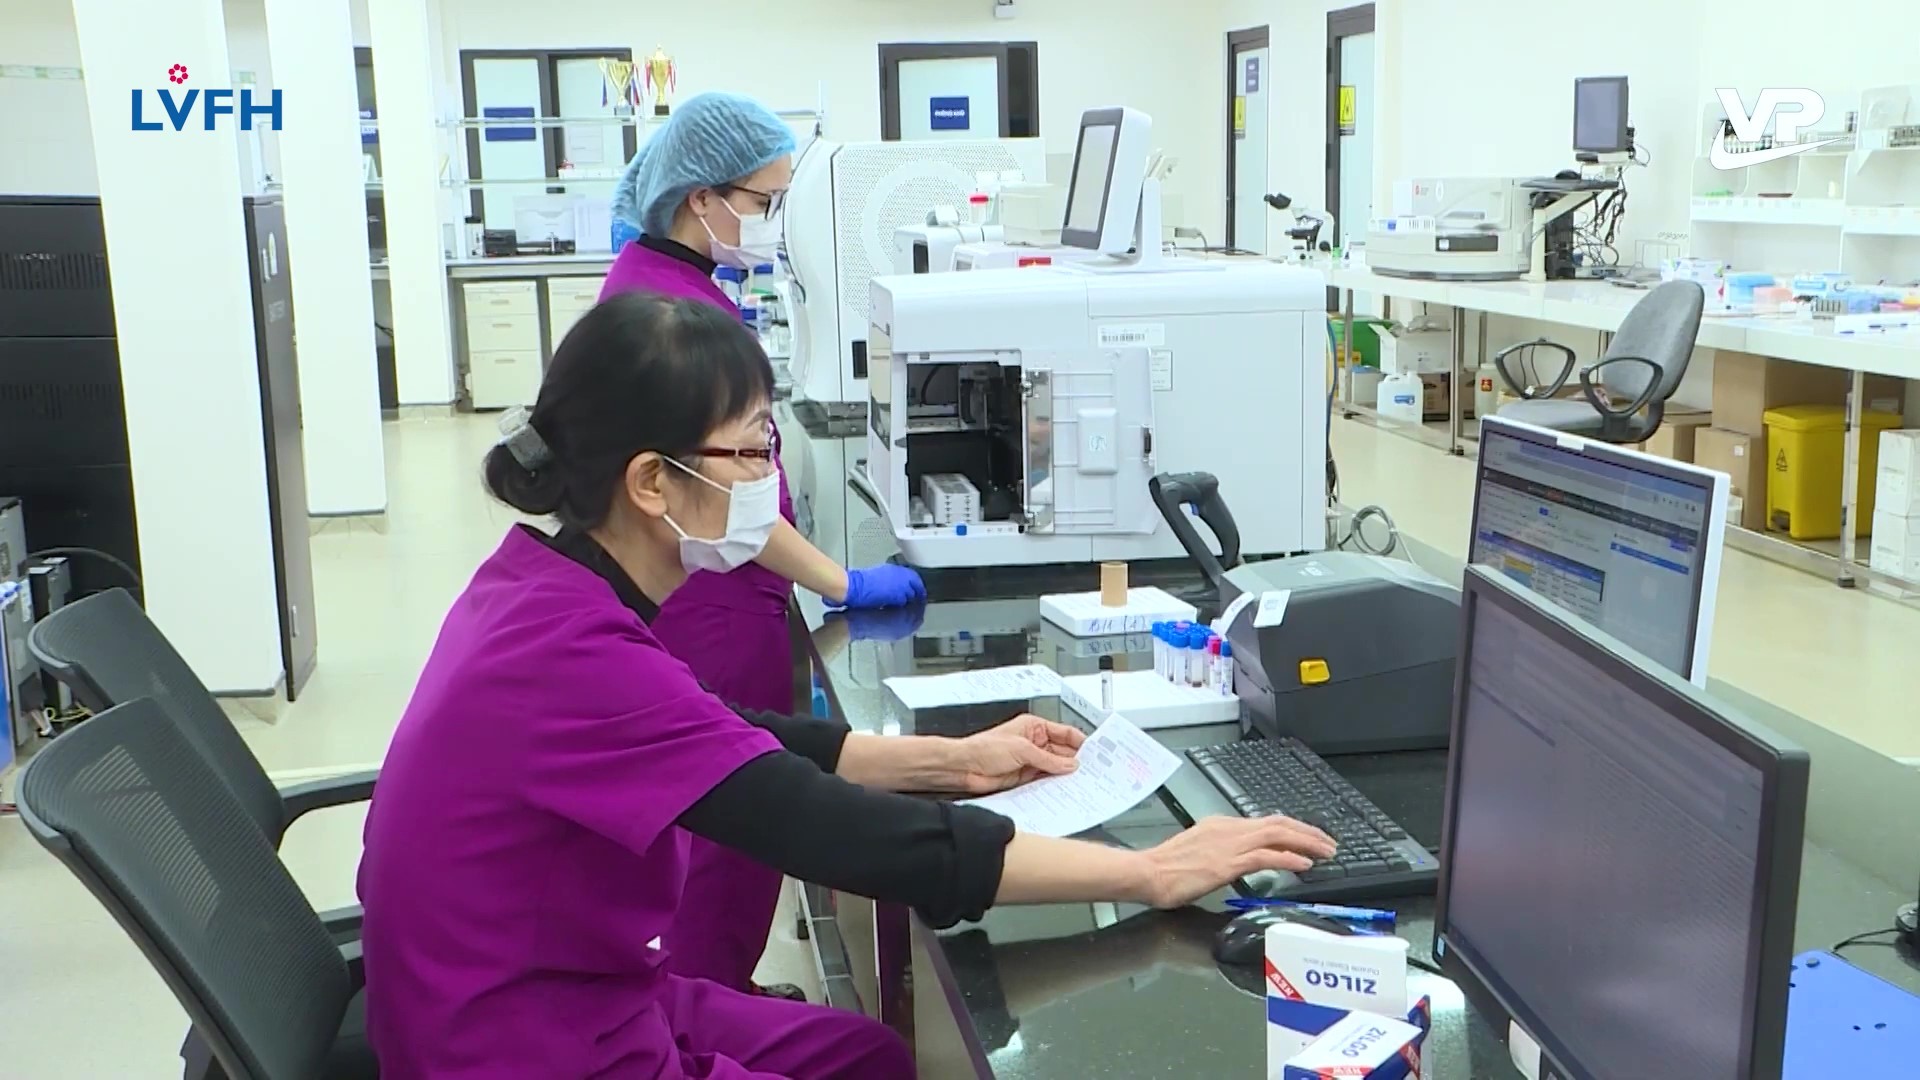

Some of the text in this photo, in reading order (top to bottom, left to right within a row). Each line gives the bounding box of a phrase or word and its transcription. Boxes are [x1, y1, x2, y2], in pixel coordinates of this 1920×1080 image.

[1271, 973, 1294, 996] NEW
[1305, 969, 1377, 995] ZILGO
[1341, 1027, 1387, 1058] ZILGO
